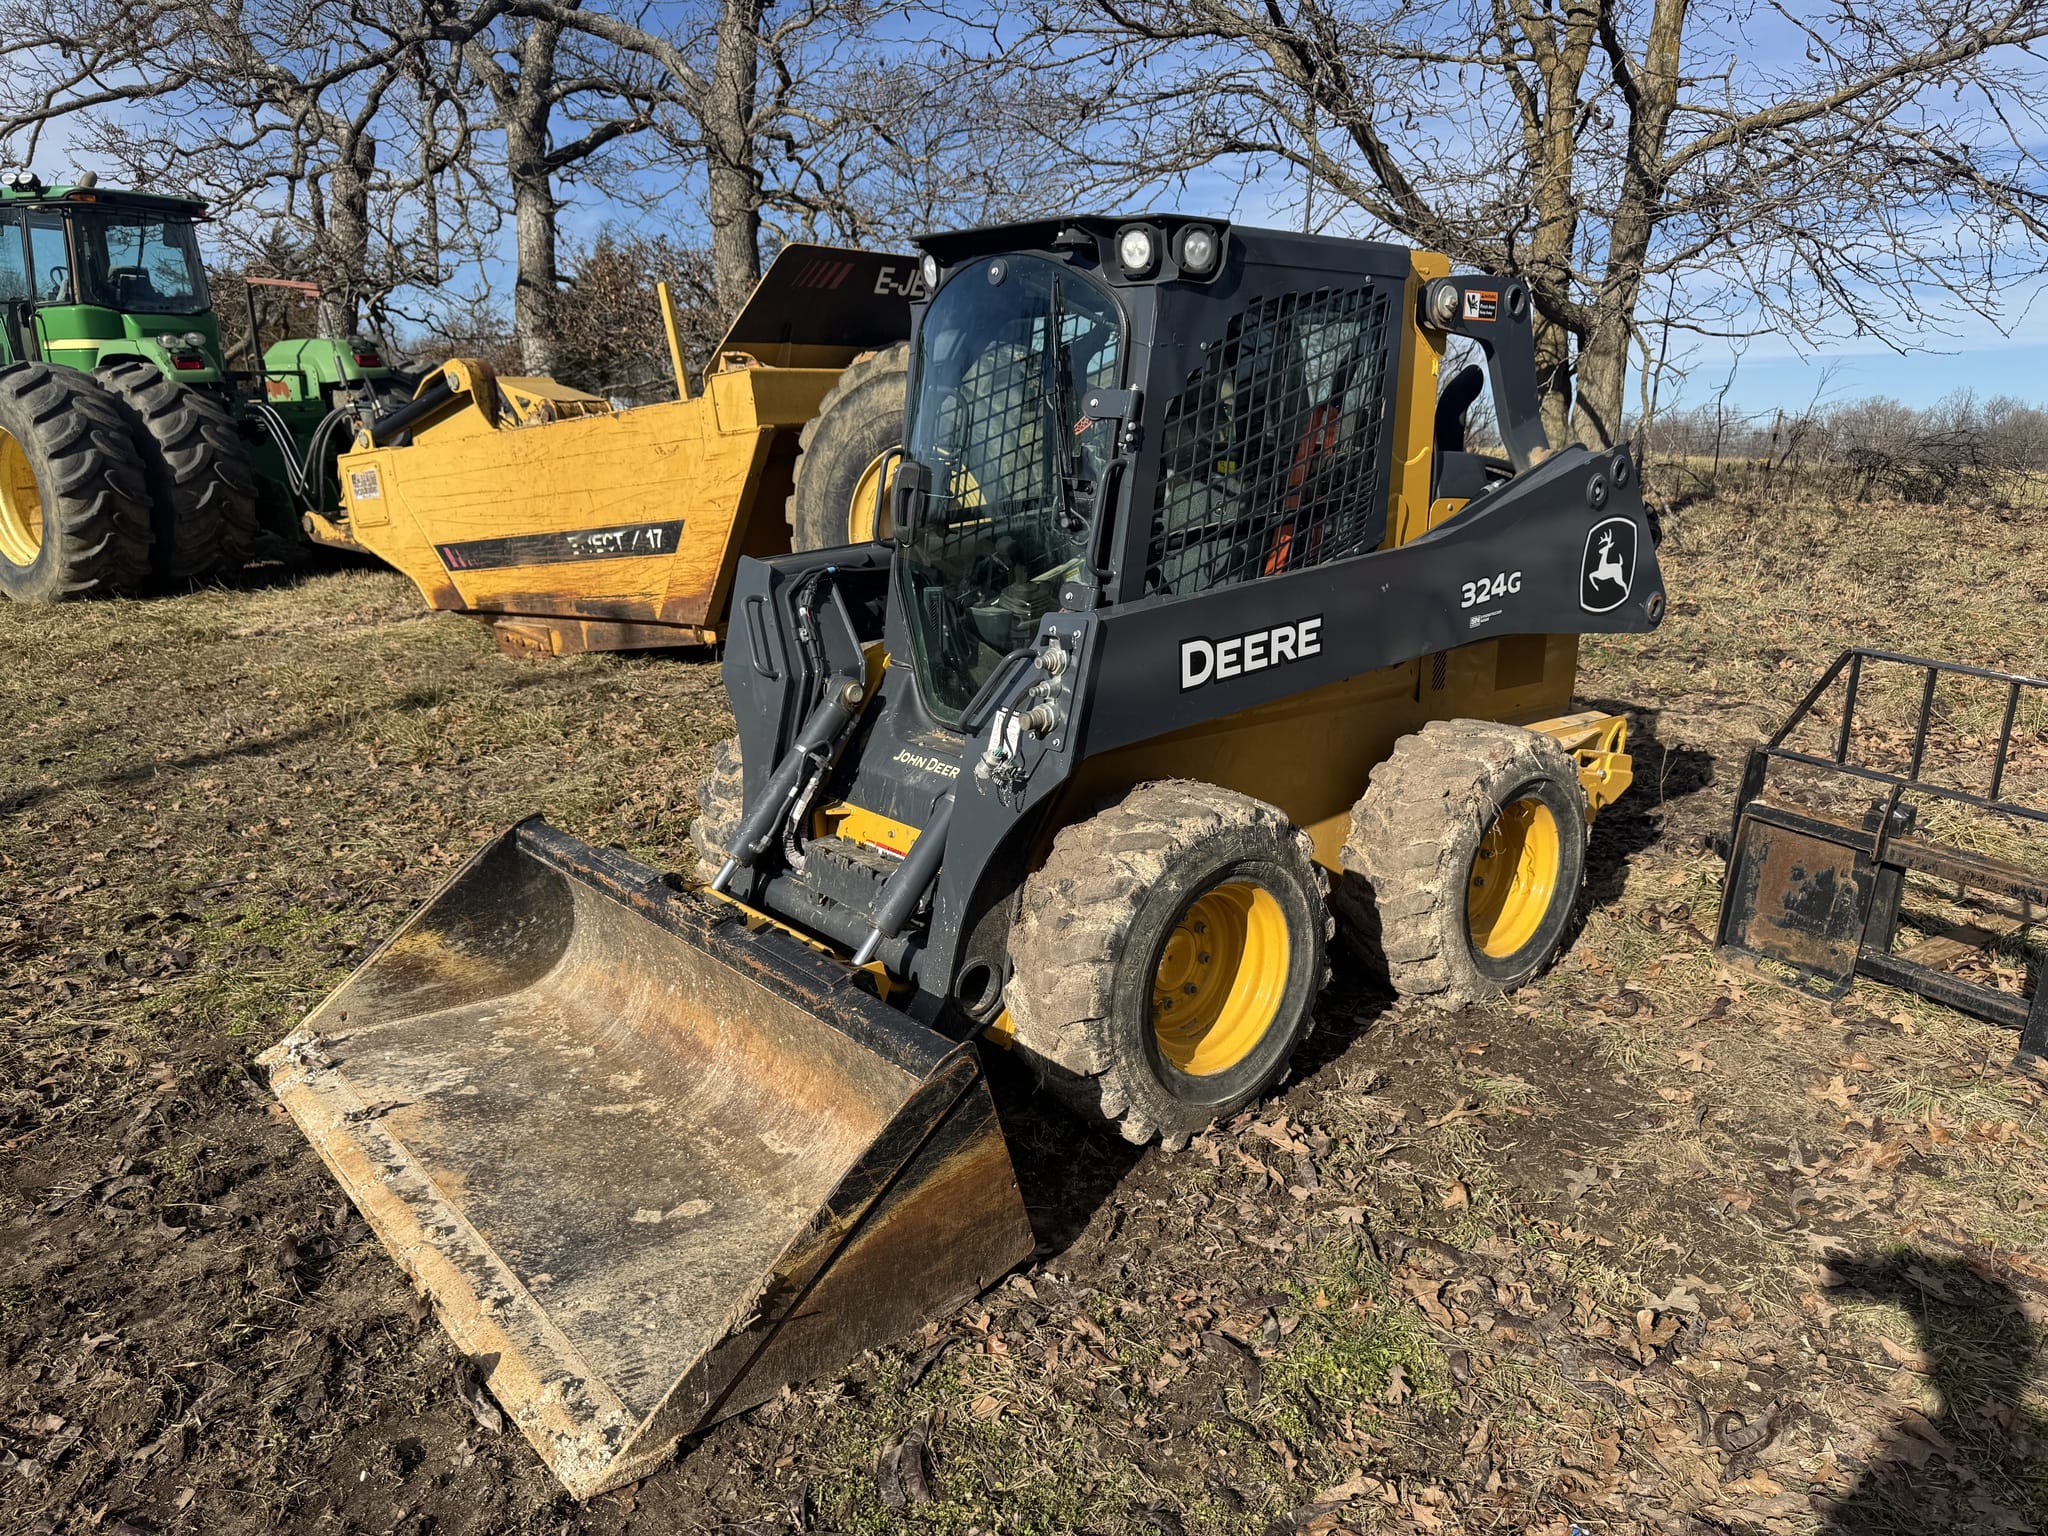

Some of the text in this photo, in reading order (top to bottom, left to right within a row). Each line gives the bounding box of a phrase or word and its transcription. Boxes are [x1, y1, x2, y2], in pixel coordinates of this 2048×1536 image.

[645, 528, 663, 549] 17
[1461, 571, 1521, 608] 324G
[1181, 618, 1322, 689] DEERE
[893, 749, 927, 768] JOHN
